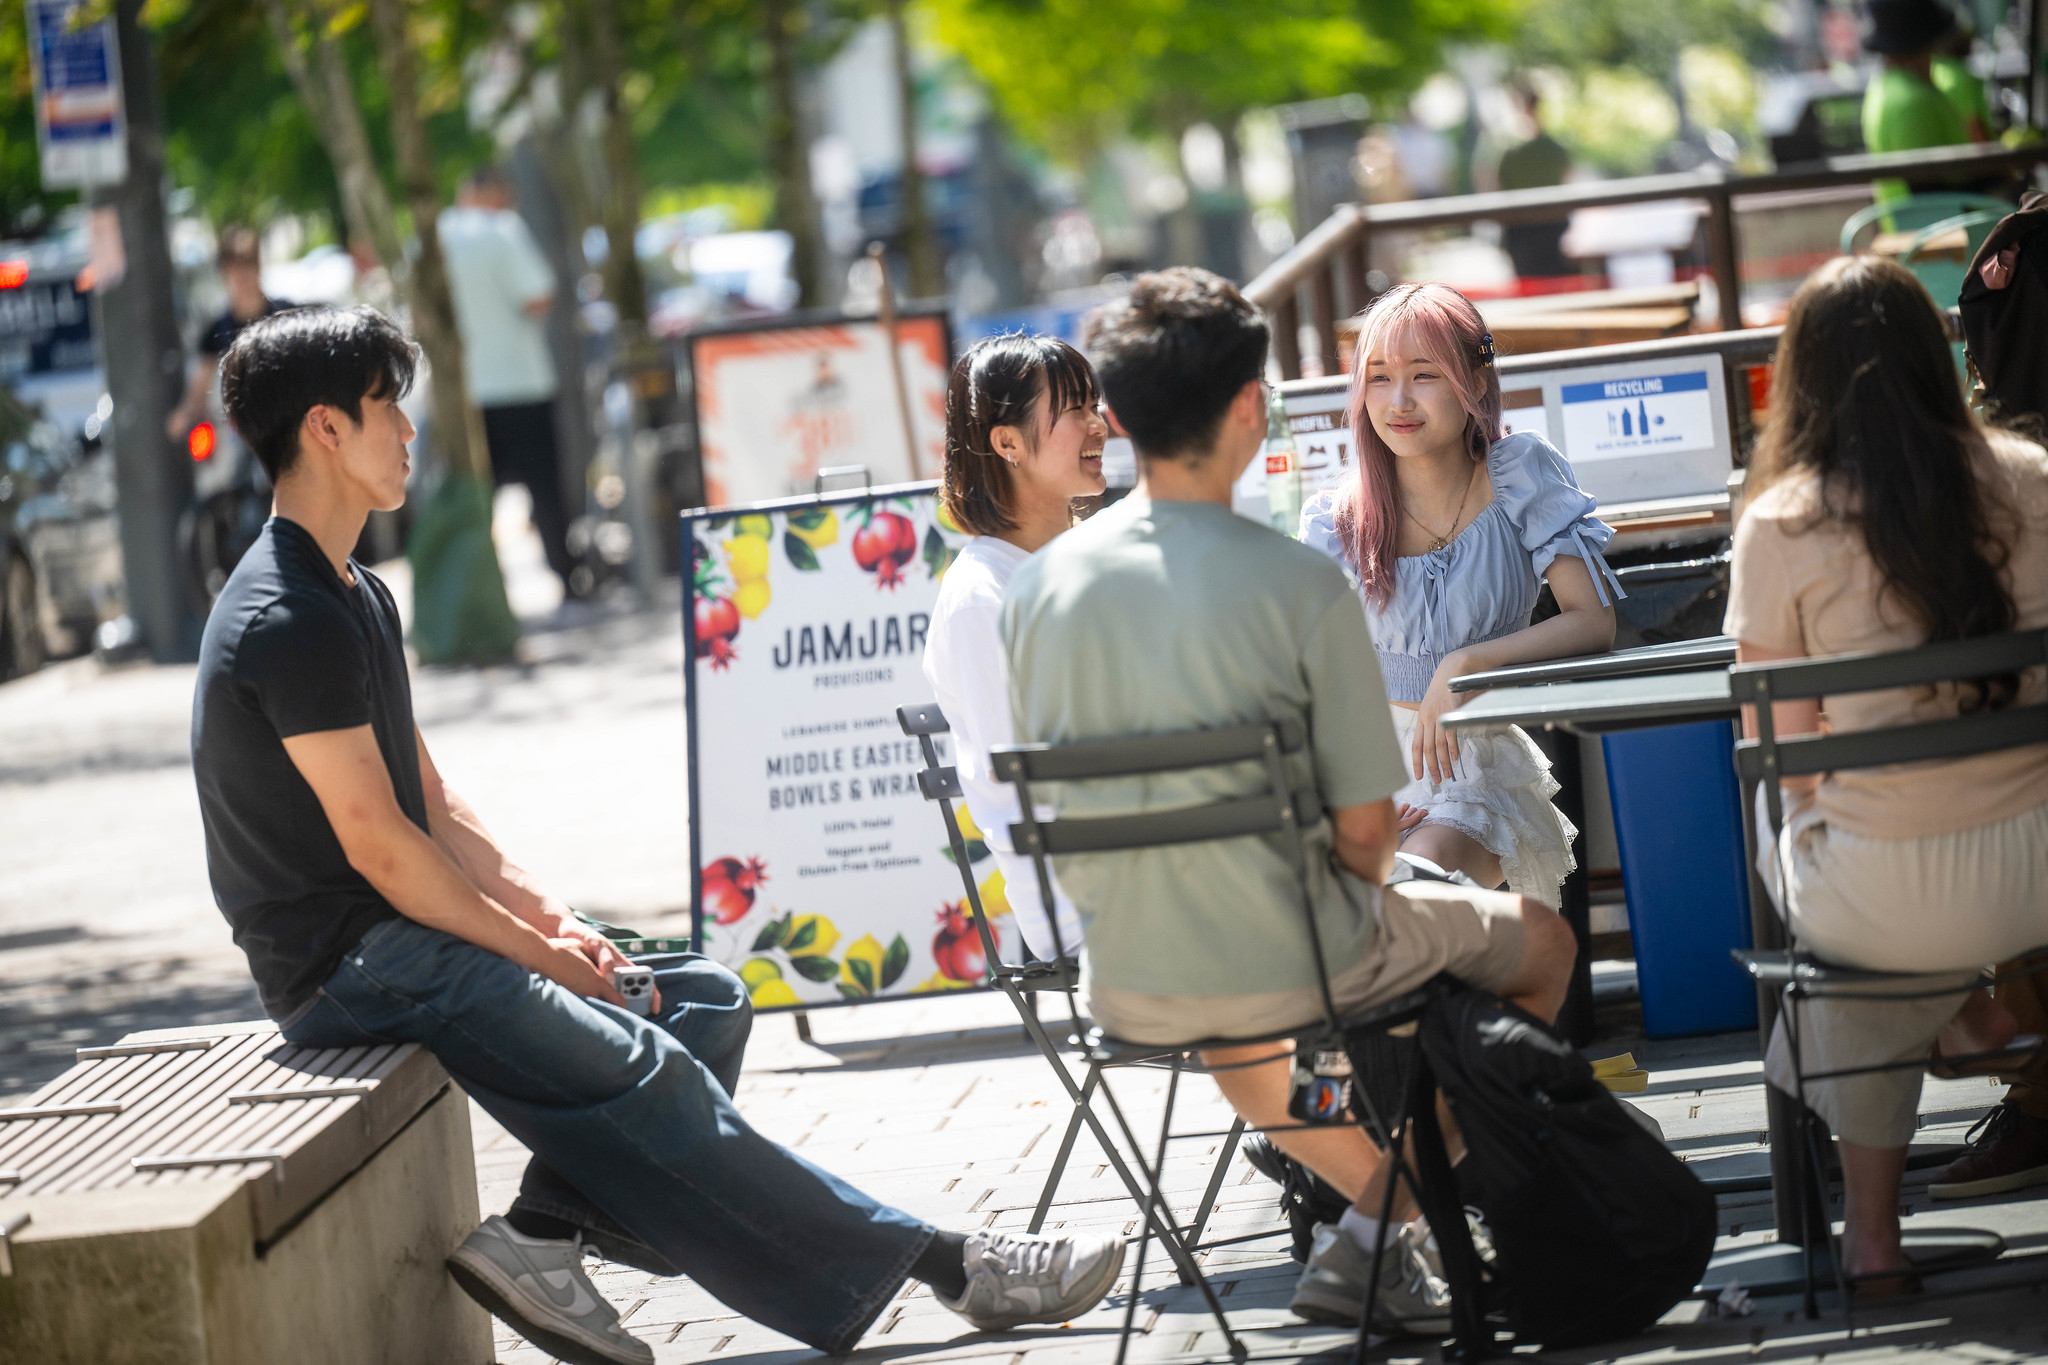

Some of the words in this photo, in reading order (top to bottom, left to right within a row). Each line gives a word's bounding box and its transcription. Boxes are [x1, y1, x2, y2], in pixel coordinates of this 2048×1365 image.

[1604, 378, 1664, 397] RECYCLING
[1290, 414, 1334, 432] ANDFILL
[773, 613, 930, 668] JAMJAR
[814, 668, 893, 688] PROVISIONS
[767, 750, 843, 777] MIDDLE
[769, 780, 842, 811] BOWLS
[850, 779, 863, 800] &
[870, 774, 920, 798] WRA
[824, 820, 857, 833] 100%
[861, 816, 893, 829] Halal
[826, 845, 863, 859] Vegan
[868, 841, 891, 853] and
[798, 864, 837, 878] Gluten
[841, 860, 869, 872] Free
[873, 856, 921, 870] Options
